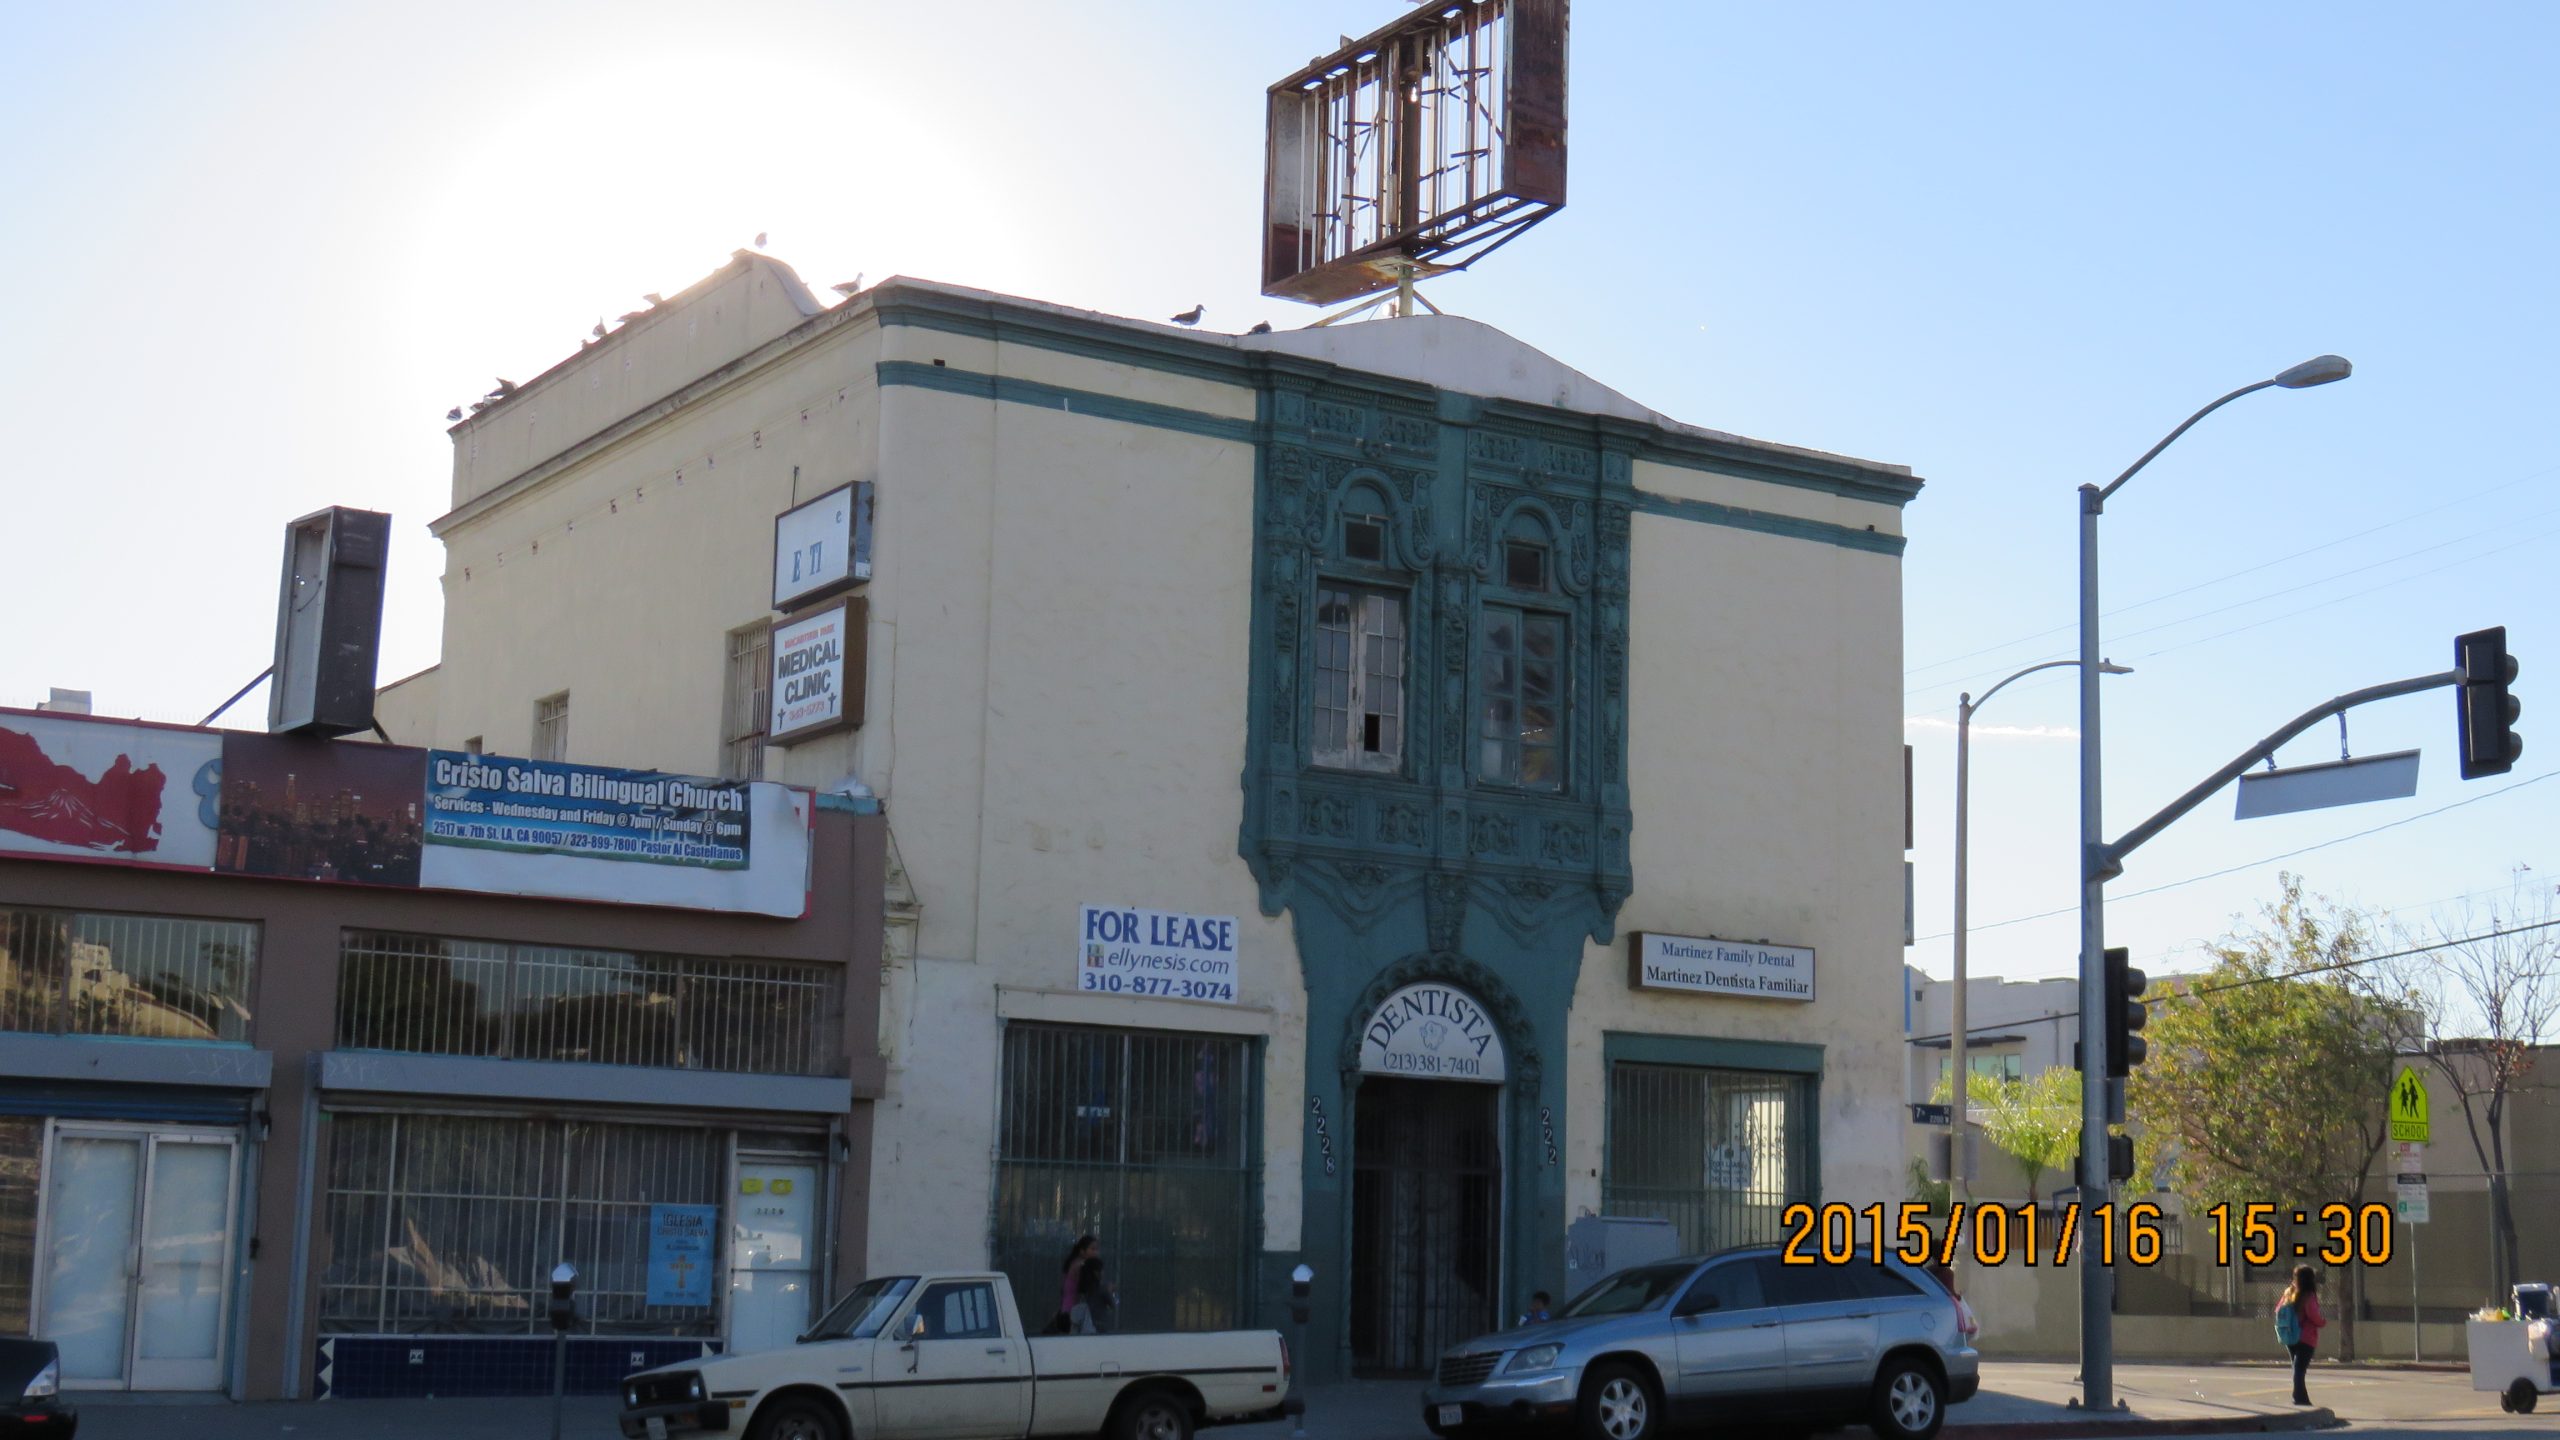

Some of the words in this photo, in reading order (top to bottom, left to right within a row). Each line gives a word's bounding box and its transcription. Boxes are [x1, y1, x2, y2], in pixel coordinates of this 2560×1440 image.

[778, 638, 840, 679] MEDICAL
[785, 669, 831, 705] CLINIC
[436, 759, 502, 790] Cristo
[507, 766, 565, 796] Salva
[570, 773, 665, 805] Bilingual
[669, 782, 743, 811] Church
[434, 795, 484, 813] Services
[492, 802, 558, 822] Wednesday
[560, 808, 580, 823] and
[583, 810, 615, 826] Friday
[617, 813, 629, 827] @
[630, 814, 651, 829] 7pm
[663, 818, 703, 835] Sunday
[704, 820, 715, 834] @
[716, 822, 741, 836] 6pm
[434, 821, 455, 835] 2517
[470, 825, 484, 838] 7th
[517, 830, 530, 843] CA
[532, 831, 562, 845] 90057
[570, 834, 637, 851] 323-899-7800
[641, 841, 671, 855] Pastor
[684, 844, 742, 859] Castellanos
[1086, 909, 1140, 944] FOR
[1151, 915, 1232, 951] LEASE
[1108, 948, 1229, 974] ellynesis.com
[1661, 942, 1713, 960] Martinez
[1716, 947, 1754, 967] Family
[1758, 951, 1795, 968] Dental
[1084, 972, 1232, 1000] 310-877-3074
[1646, 966, 1702, 985] Martinez
[1705, 970, 1756, 989] Dentista
[1759, 975, 1809, 994] Familiar
[1367, 990, 1492, 1058] DENTISTA
[1312, 1096, 1335, 1173] 2228
[2392, 1124, 2427, 1139] SCHOOL
[663, 1213, 703, 1227] IGLESIA
